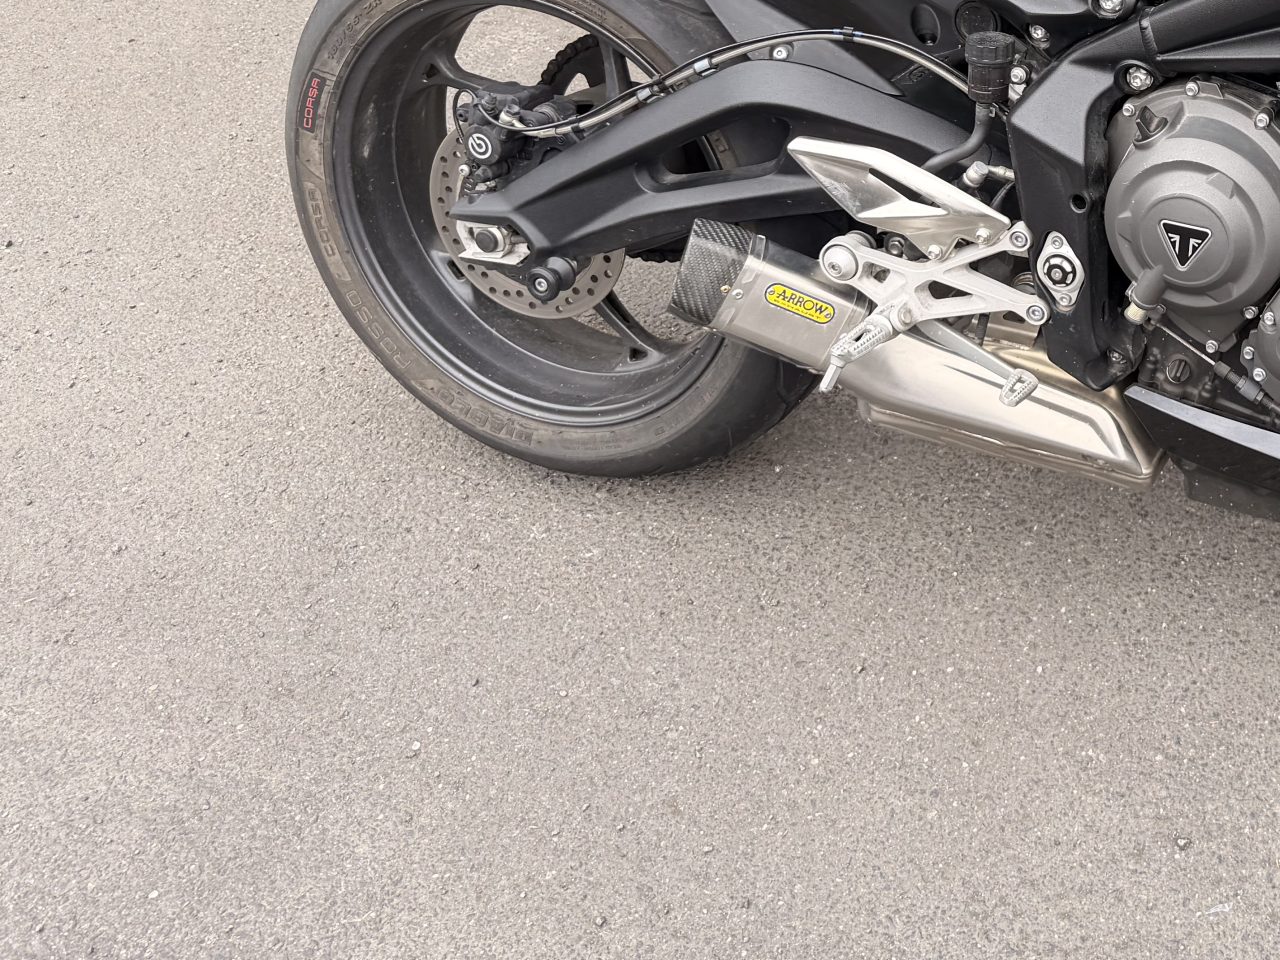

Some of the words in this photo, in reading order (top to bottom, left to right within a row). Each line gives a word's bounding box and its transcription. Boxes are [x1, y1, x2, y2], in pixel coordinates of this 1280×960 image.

[303, 77, 321, 129] CORSA
[307, 188, 337, 258] CORSA
[345, 289, 412, 369] ROSSO
[776, 289, 829, 315] ARROW
